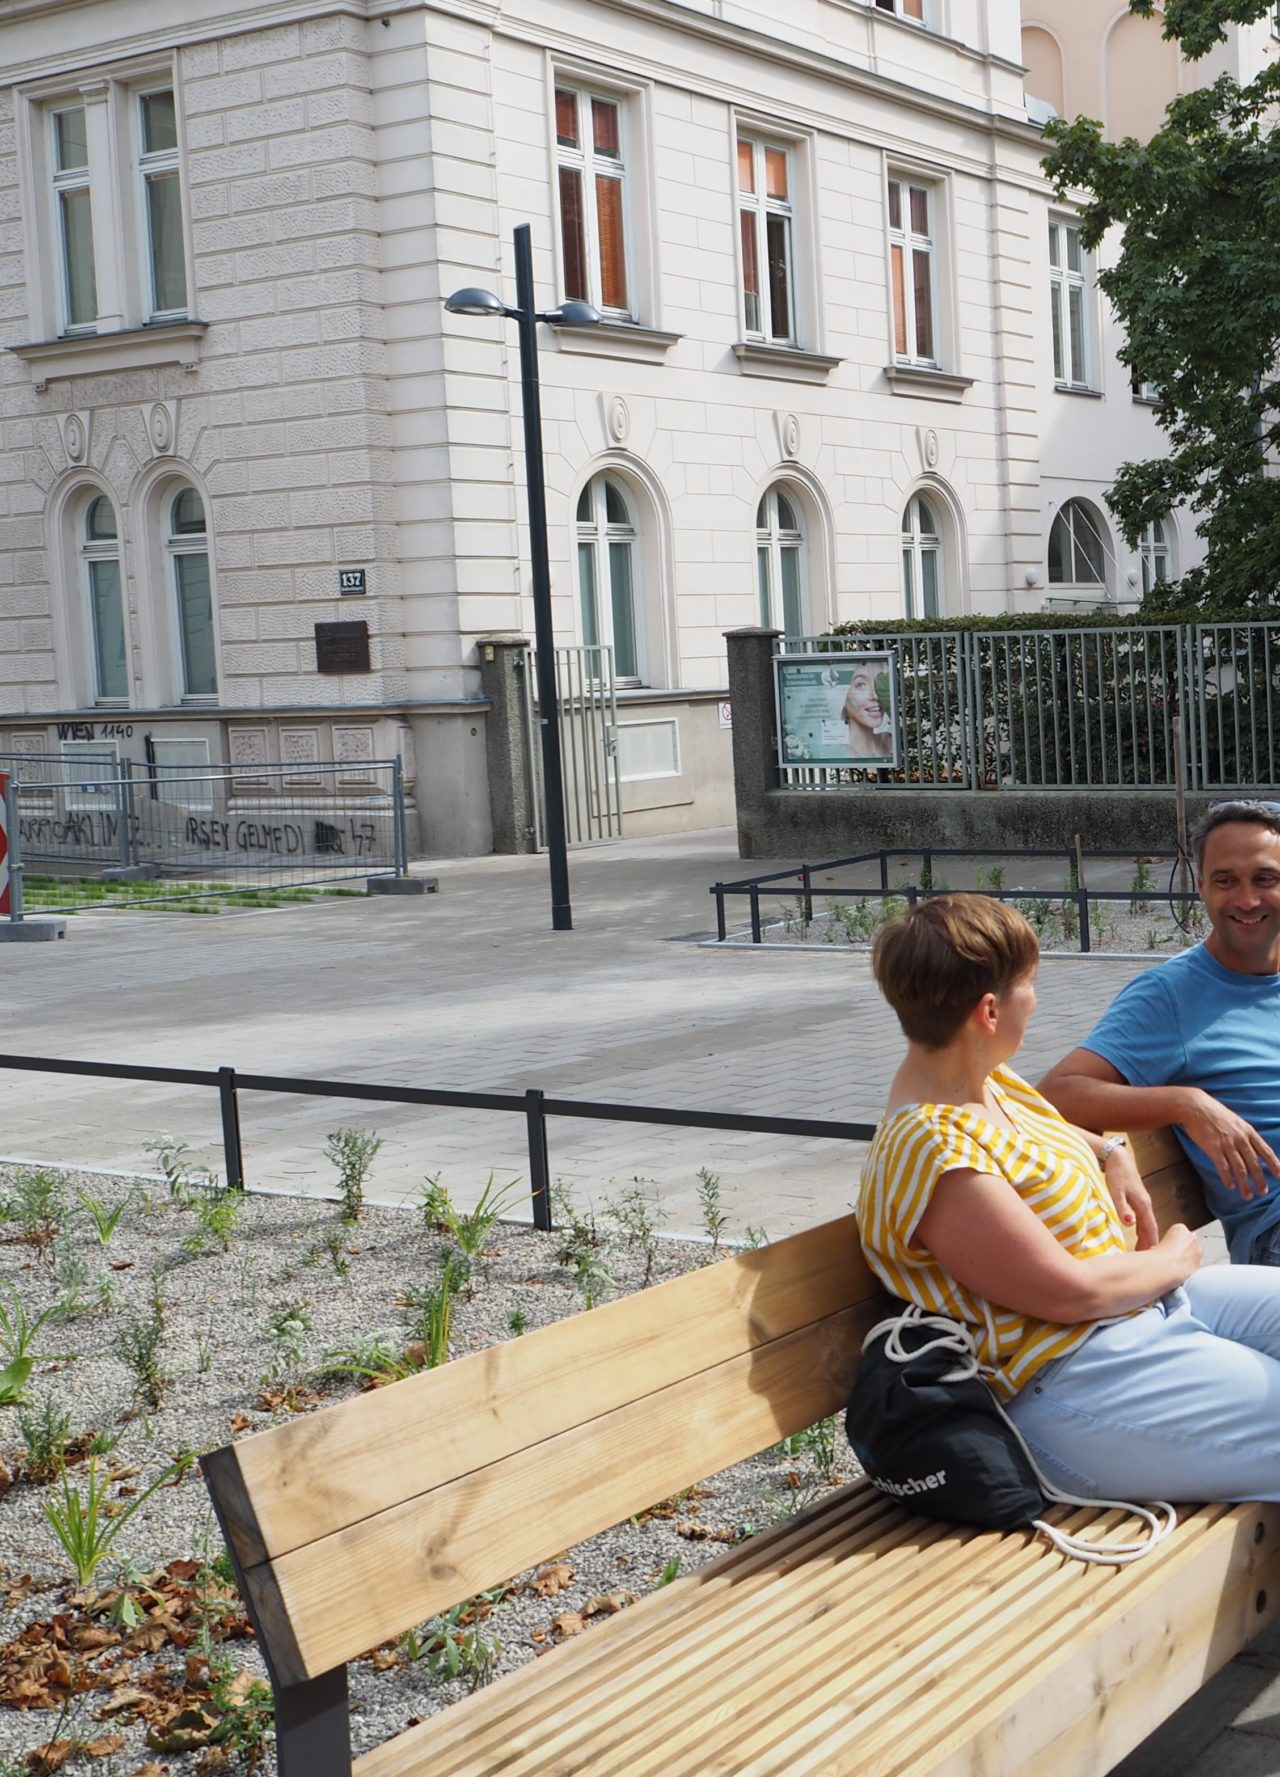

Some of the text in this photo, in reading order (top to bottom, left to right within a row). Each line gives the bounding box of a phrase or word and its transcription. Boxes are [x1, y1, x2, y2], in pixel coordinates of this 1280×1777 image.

[342, 572, 362, 587] 137
[56, 722, 134, 741] WIEN 1140
